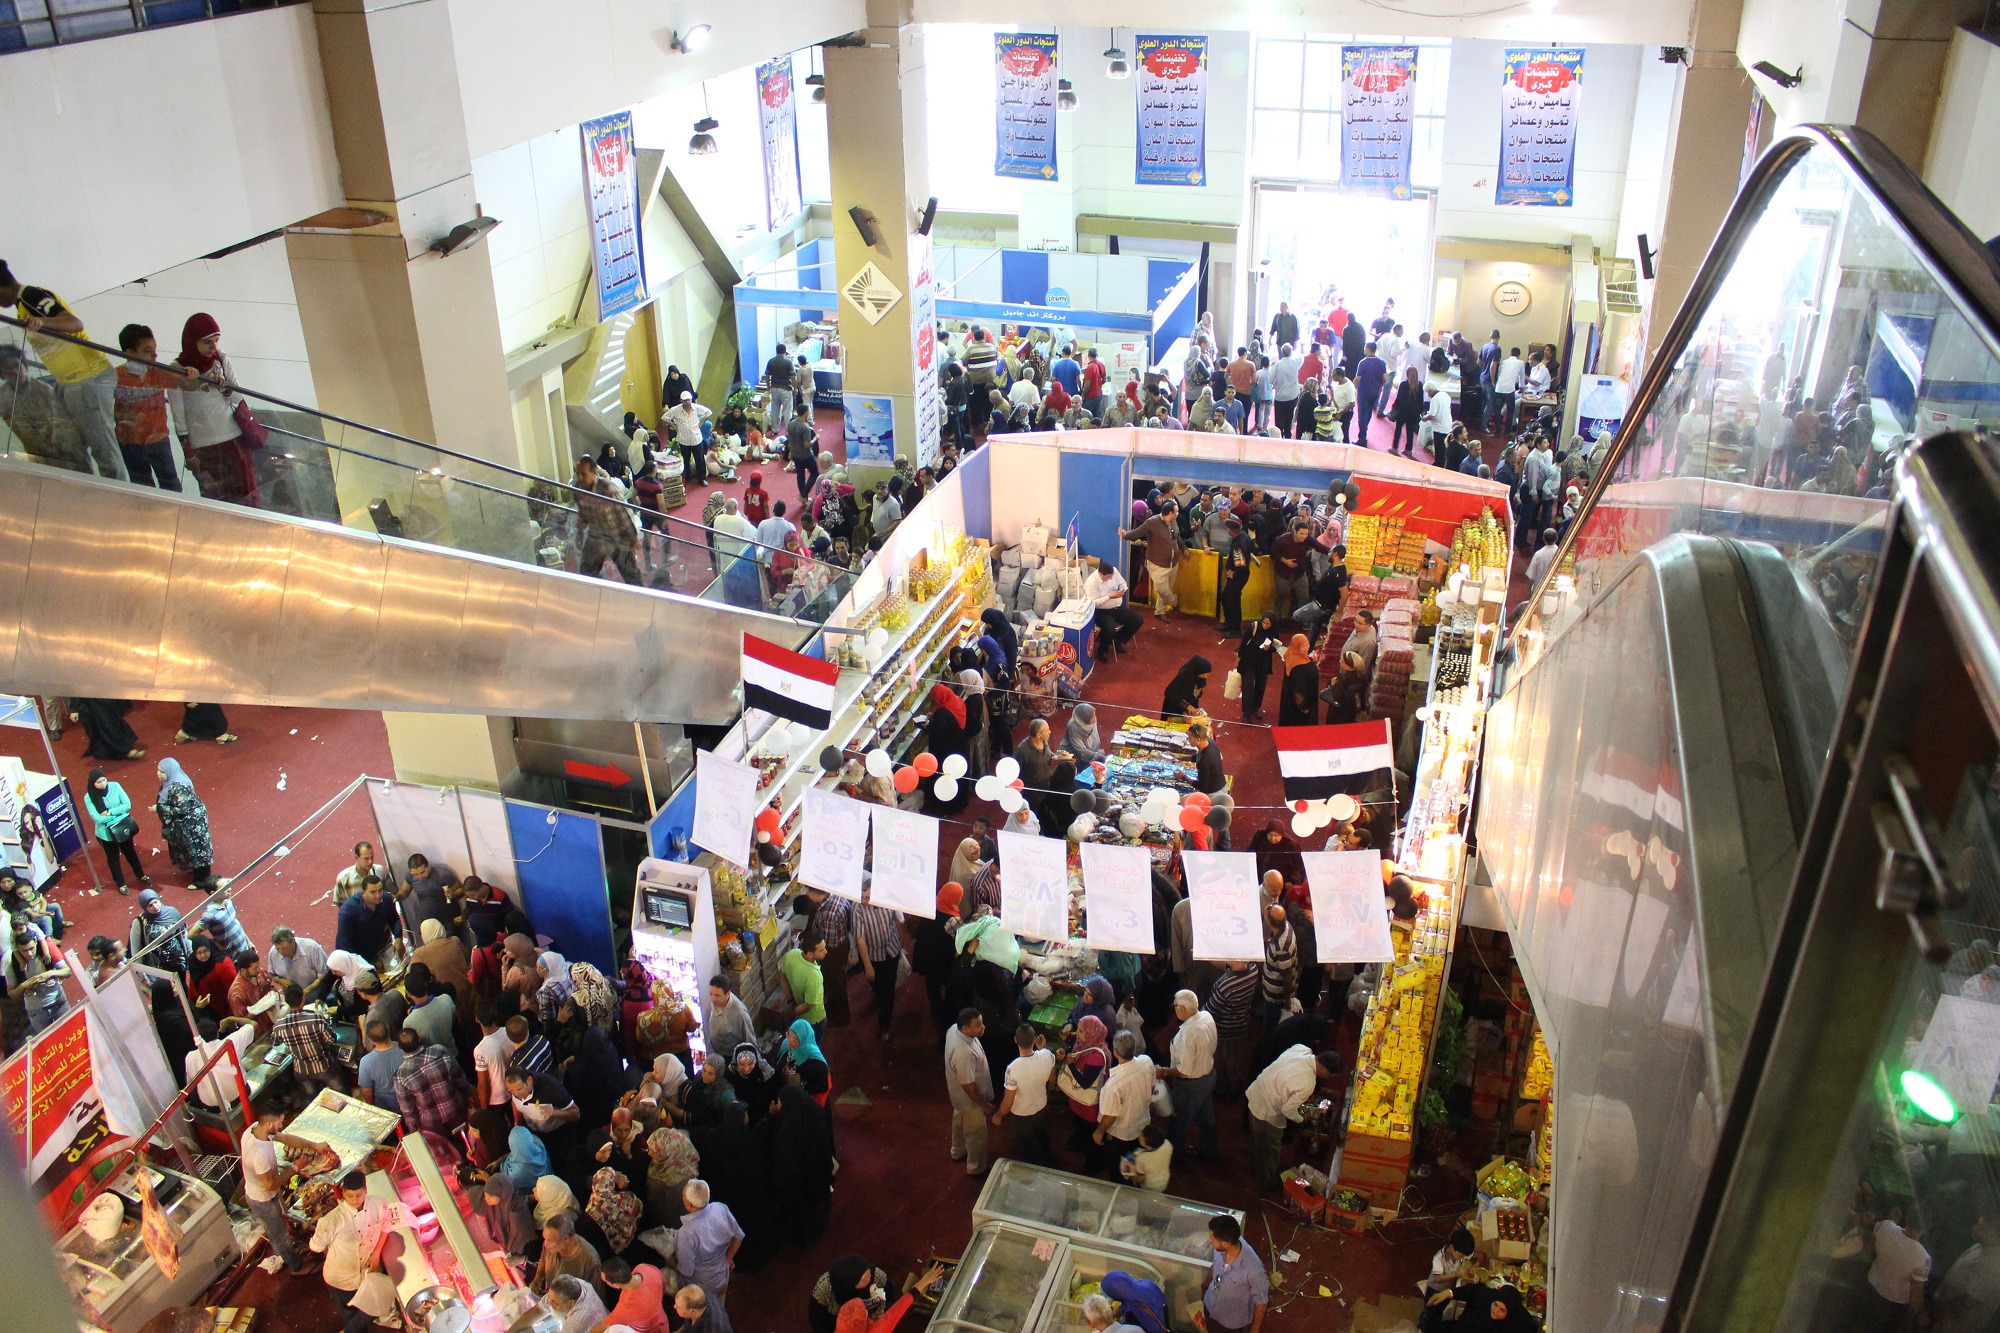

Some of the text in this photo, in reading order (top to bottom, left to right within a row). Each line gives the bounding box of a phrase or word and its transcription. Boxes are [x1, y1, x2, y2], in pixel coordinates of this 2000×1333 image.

[1015, 37, 1032, 47] الدور
[1033, 36, 1055, 48] منتجات
[1160, 39, 1179, 50] الدور
[1180, 38, 1205, 51] منتجات
[1012, 51, 1040, 63] تخفيضات
[1155, 53, 1187, 65] تخفيضات
[1531, 52, 1552, 64] الدور
[1553, 51, 1580, 64] منتجات
[1017, 64, 1035, 75] كبرى
[1161, 65, 1181, 76] كبرى
[1525, 66, 1560, 79] تخفيضات
[1143, 78, 1199, 95] ياميش رمضان
[1530, 79, 1553, 91] كبرى
[1176, 98, 1198, 112] تمور
[1347, 94, 1382, 107] دواجن
[1510, 94, 1571, 110] ياميش رمضان
[1004, 111, 1048, 128] بقوليات
[1169, 116, 1198, 130] منتجات
[1346, 112, 1409, 126] سكر عسل
[1508, 114, 1569, 129] تمور وعصائر
[1167, 134, 1196, 148] منتجات
[1351, 130, 1402, 145] بقوليات
[1535, 133, 1567, 148] منتجات
[1004, 146, 1047, 160] منظفات
[1143, 150, 1198, 166] منتجات ورقية
[1352, 148, 1400, 162] عطارة
[1532, 152, 1564, 166] منتجات
[1350, 167, 1400, 179] منظفات
[1505, 169, 1531, 184] ورقية
[1534, 171, 1565, 185] منتجات
[606, 266, 637, 291] منظفات
[1047, 294, 1068, 304] Downy
[1502, 288, 1519, 296] مكتب
[1040, 312, 1067, 322] بروكتر
[1115, 353, 1121, 368] 1
